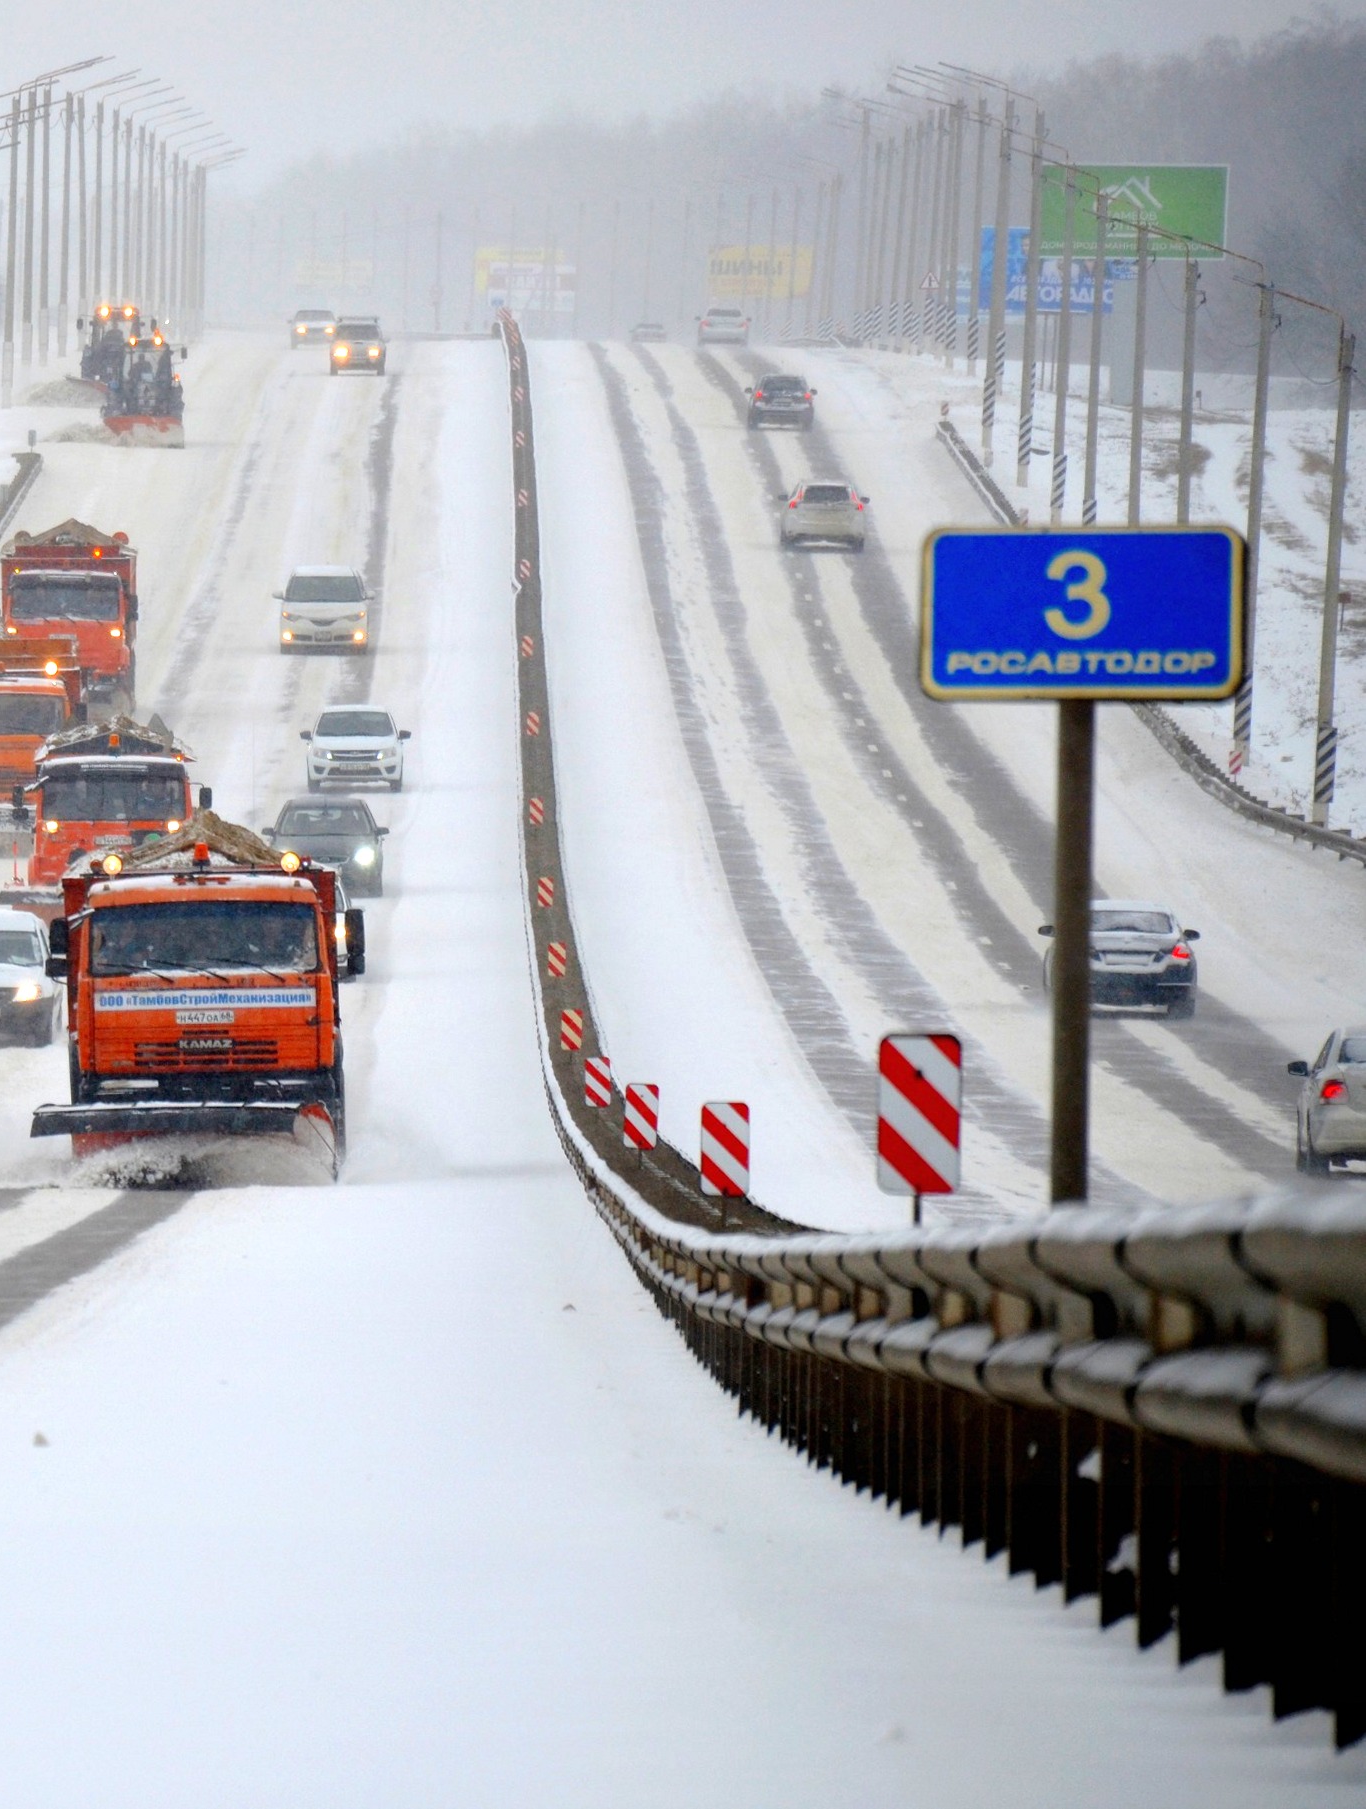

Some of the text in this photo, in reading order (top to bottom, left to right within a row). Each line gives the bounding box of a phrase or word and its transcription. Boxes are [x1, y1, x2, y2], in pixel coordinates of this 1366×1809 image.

[1044, 550, 1111, 640] 3
[947, 651, 1216, 674] РОСАВТОДОР
[99, 991, 312, 1007] ООО «ТамбовСтройМеханизация»
[179, 1039, 234, 1049] KAMAZ
